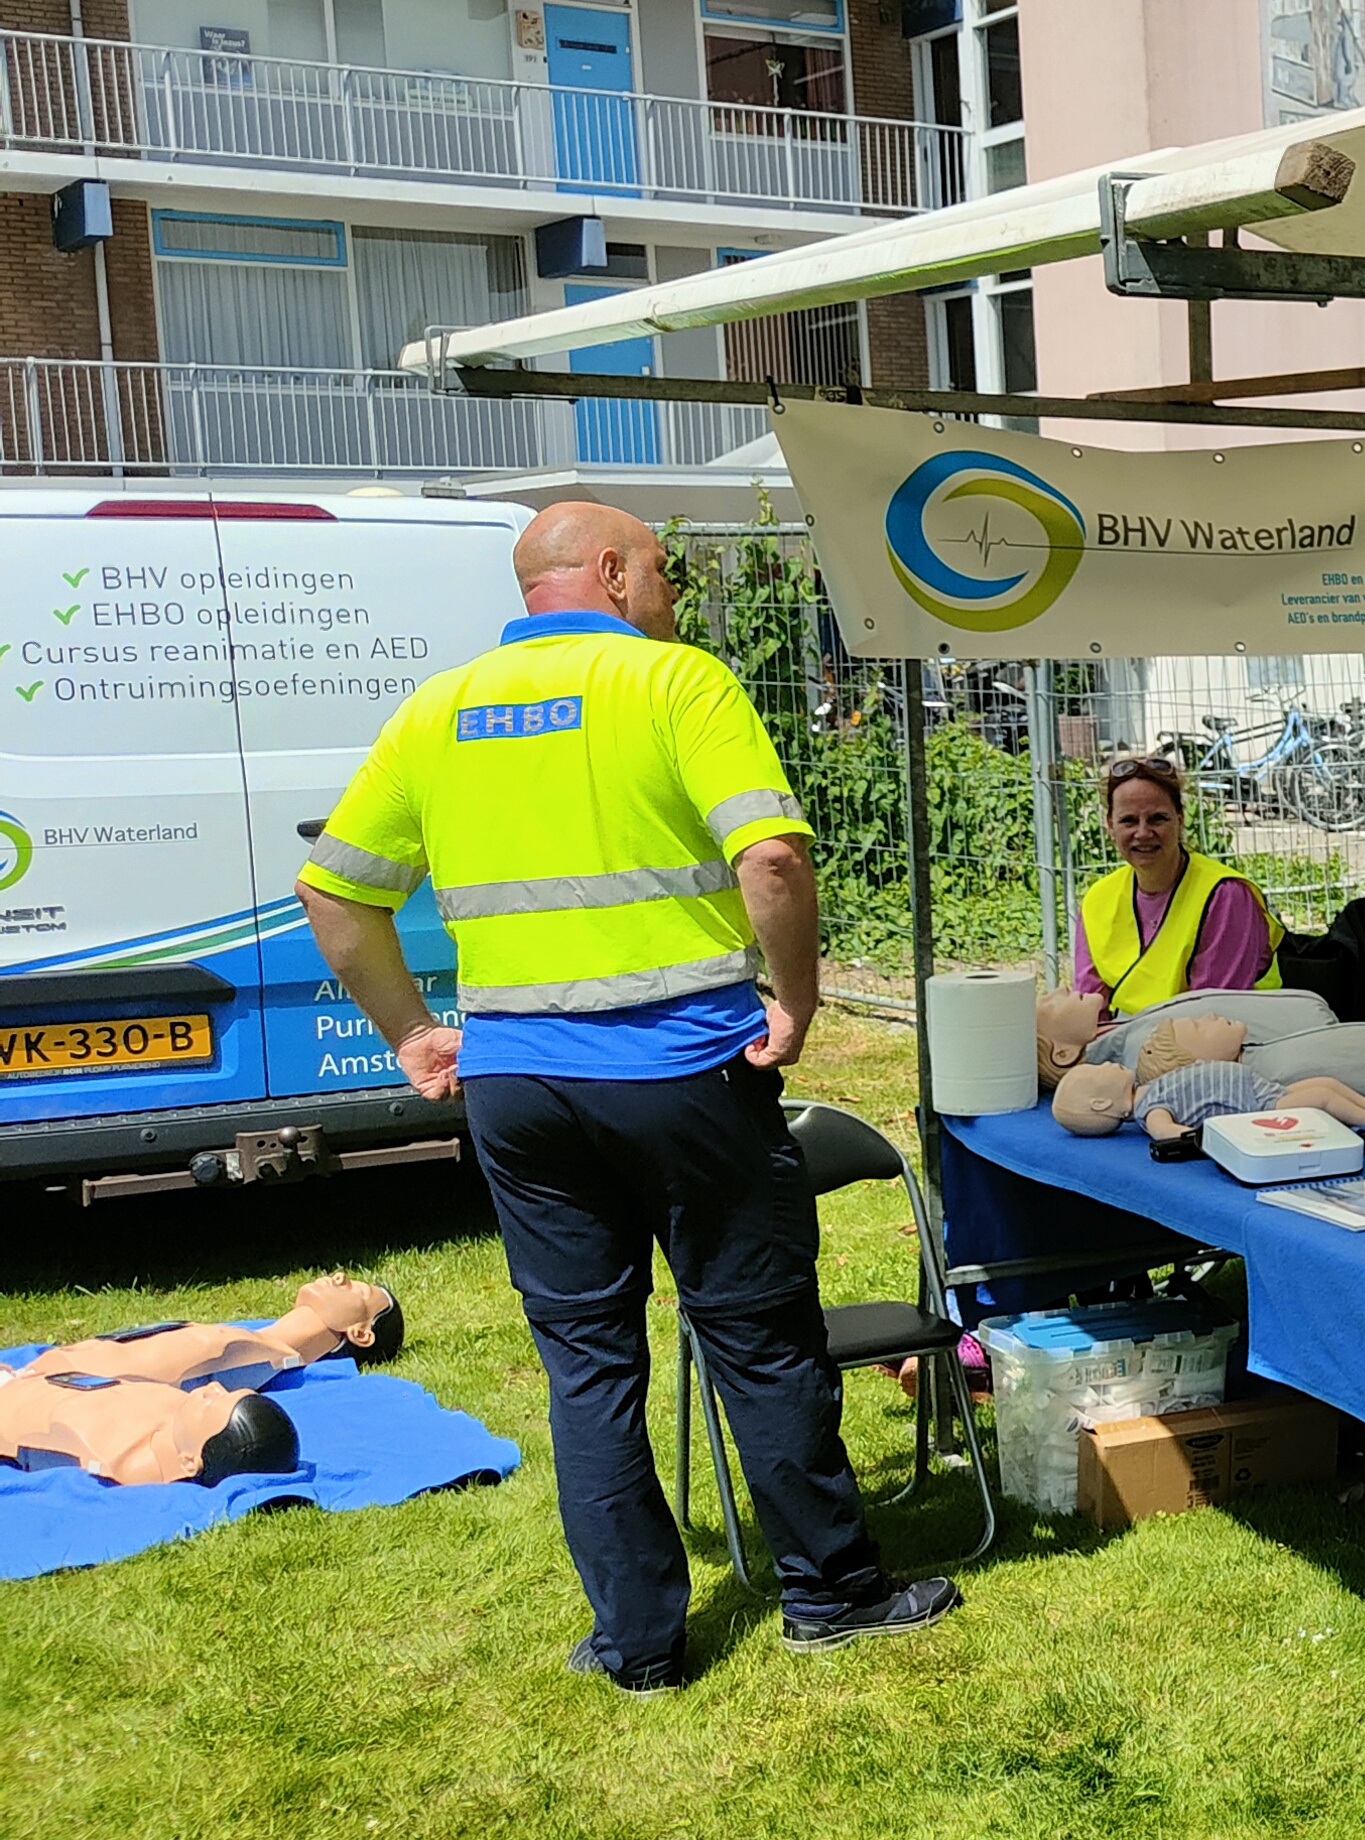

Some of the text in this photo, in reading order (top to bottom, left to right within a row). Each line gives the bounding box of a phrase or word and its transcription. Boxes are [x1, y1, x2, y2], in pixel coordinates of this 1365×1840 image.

[1097, 513, 1356, 551] BHV Waterland
[102, 566, 354, 596] BHV opleidingen
[1321, 573, 1348, 586] EHBO
[1351, 575, 1364, 585] en
[1281, 592, 1340, 606] Leverancier
[1342, 594, 1361, 603] van
[93, 601, 370, 632] EHBO opleidingen
[1288, 612, 1315, 624] AED's
[1317, 614, 1330, 623] en
[22, 637, 428, 665] Cursus reanimatie en AED
[54, 671, 417, 704] Ontruimingsoefeningen
[460, 699, 577, 737] EHBO
[44, 823, 198, 845] BHV Waterland
